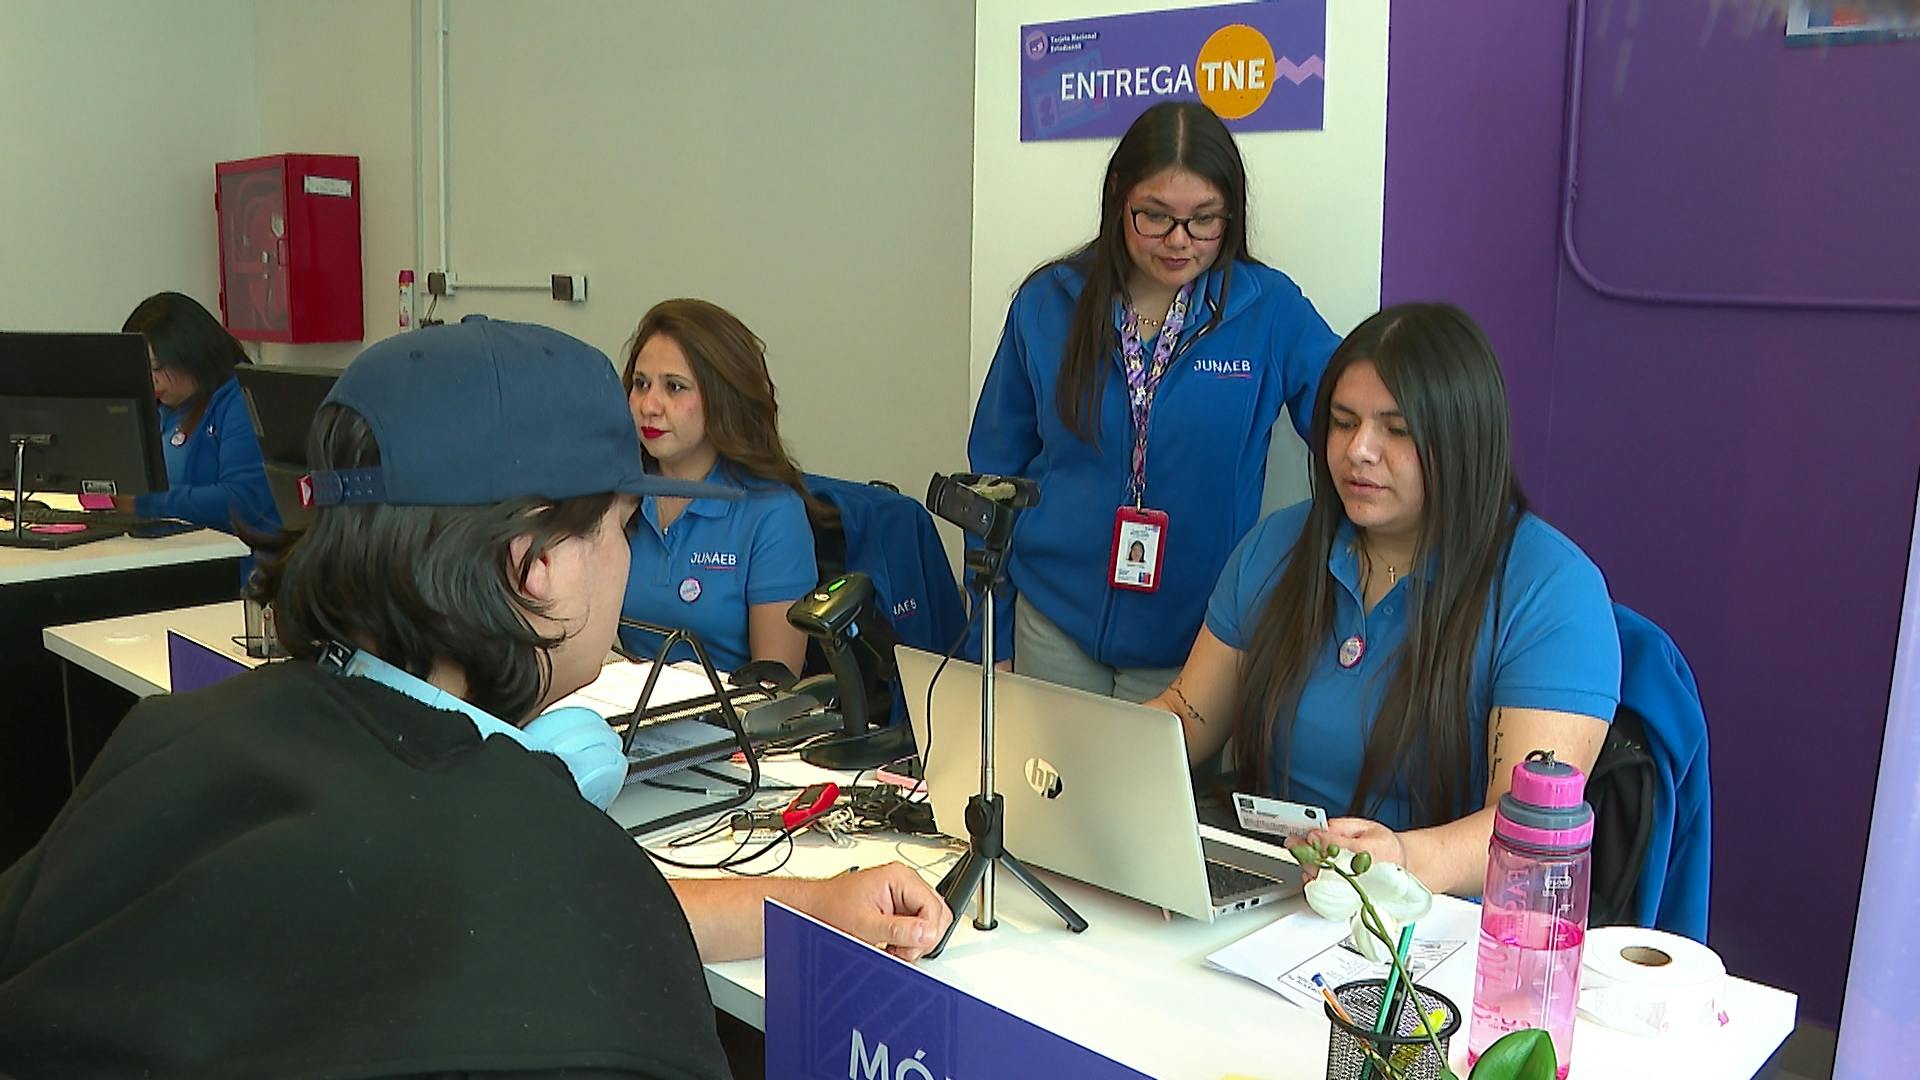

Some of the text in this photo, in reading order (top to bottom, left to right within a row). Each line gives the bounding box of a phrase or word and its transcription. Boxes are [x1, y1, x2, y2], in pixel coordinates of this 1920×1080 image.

[1061, 58, 1265, 101] ENTREGA TNE
[1193, 359, 1251, 374] JUNAEB
[690, 551, 737, 566] JUNAEB
[1030, 758, 1059, 800] hp
